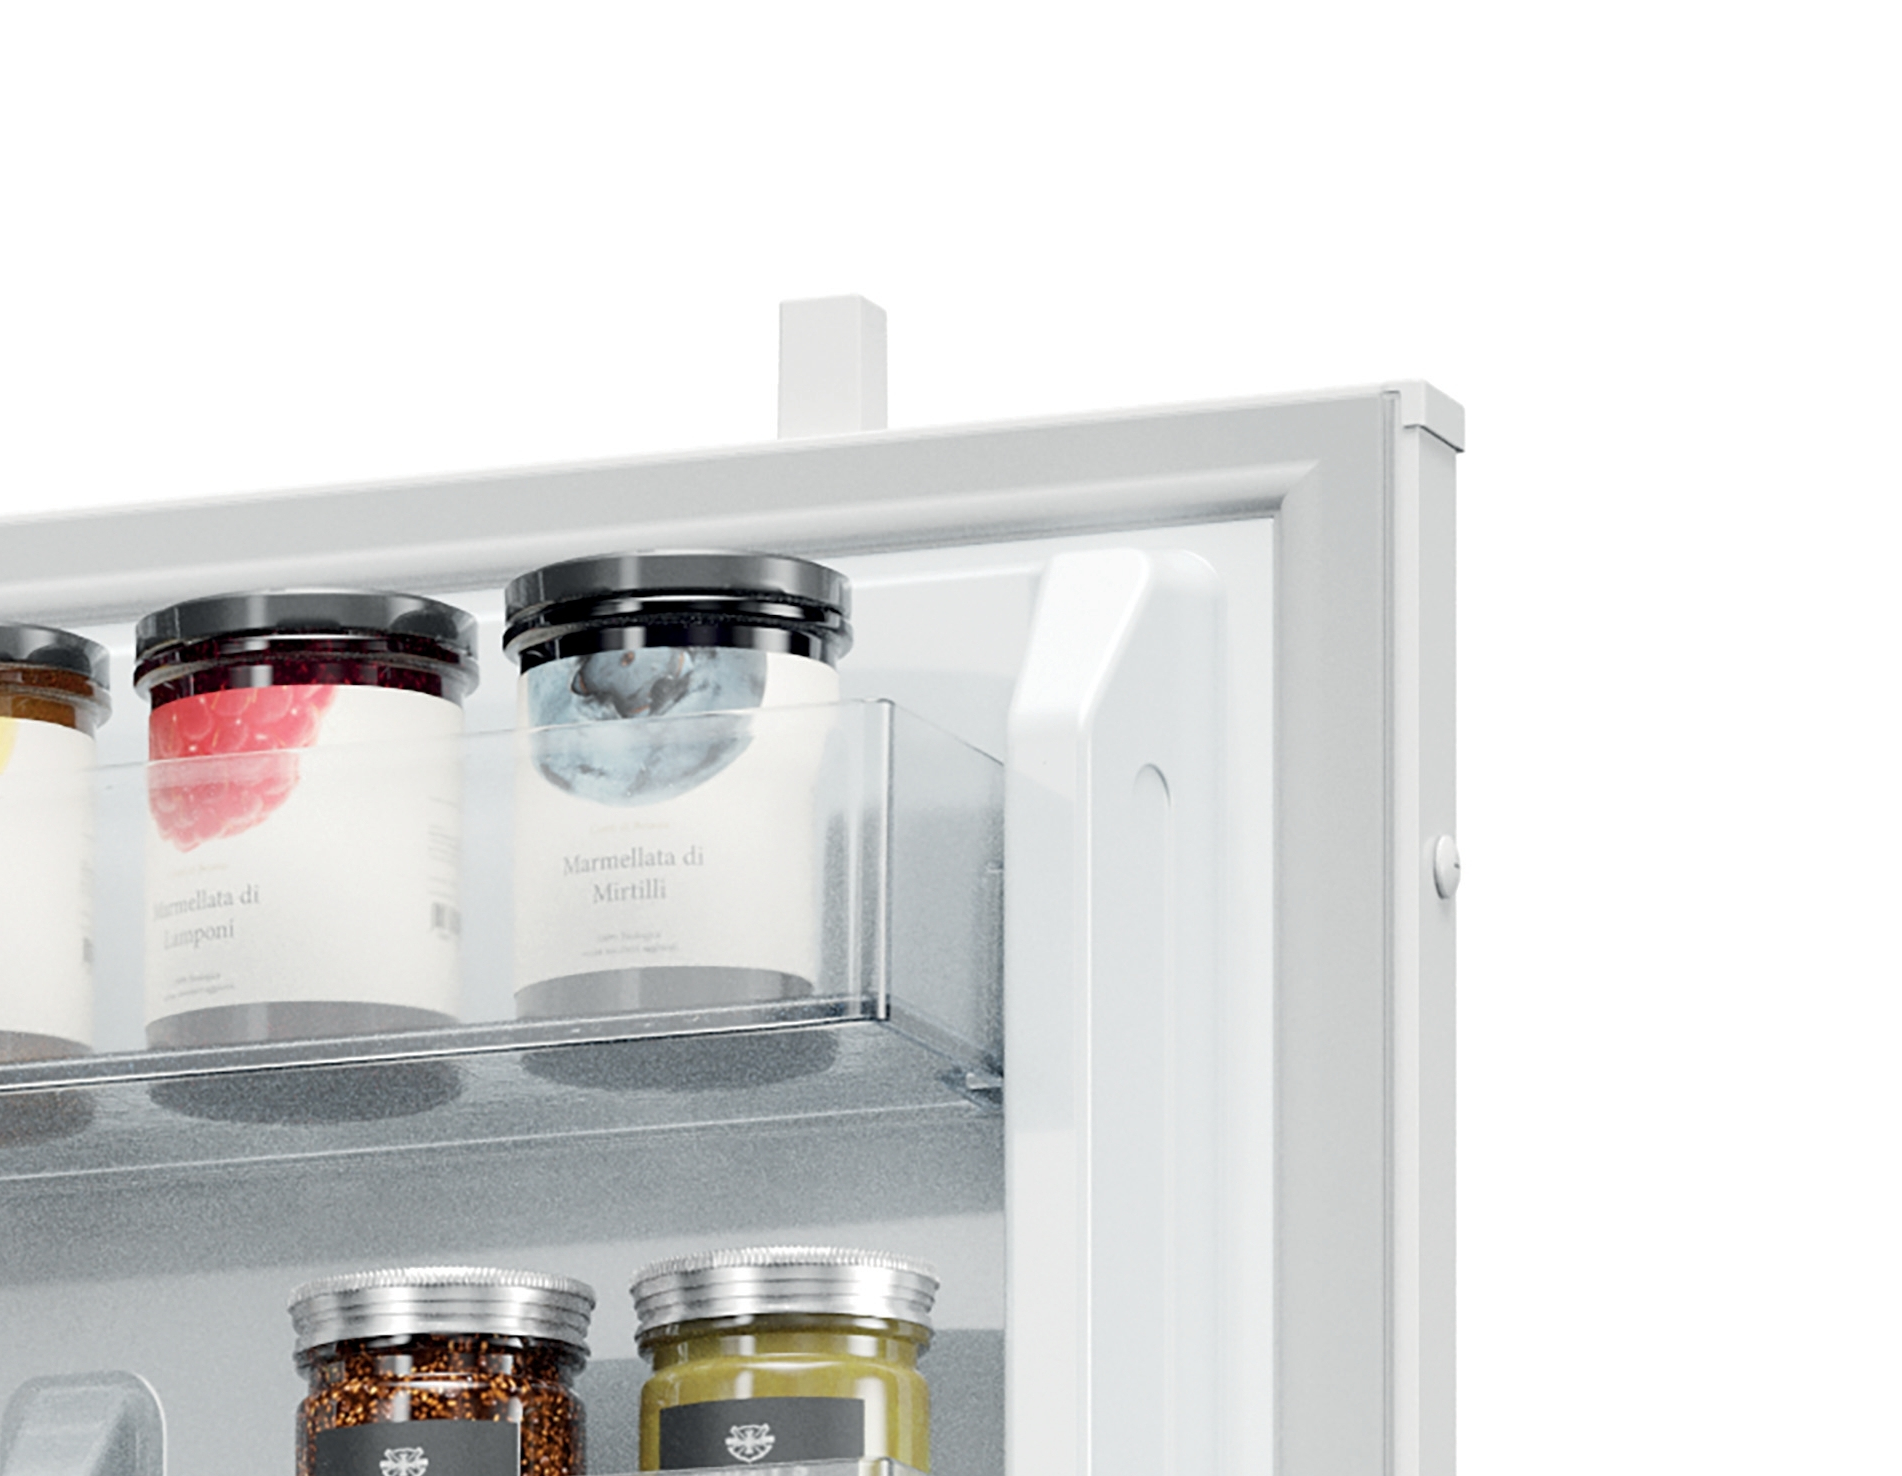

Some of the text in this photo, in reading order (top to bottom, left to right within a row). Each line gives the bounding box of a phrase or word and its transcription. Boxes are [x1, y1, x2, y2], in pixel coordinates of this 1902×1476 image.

[563, 844, 703, 876] Marmellata di
[240, 883, 260, 905] di
[592, 878, 667, 904] Mirtilli
